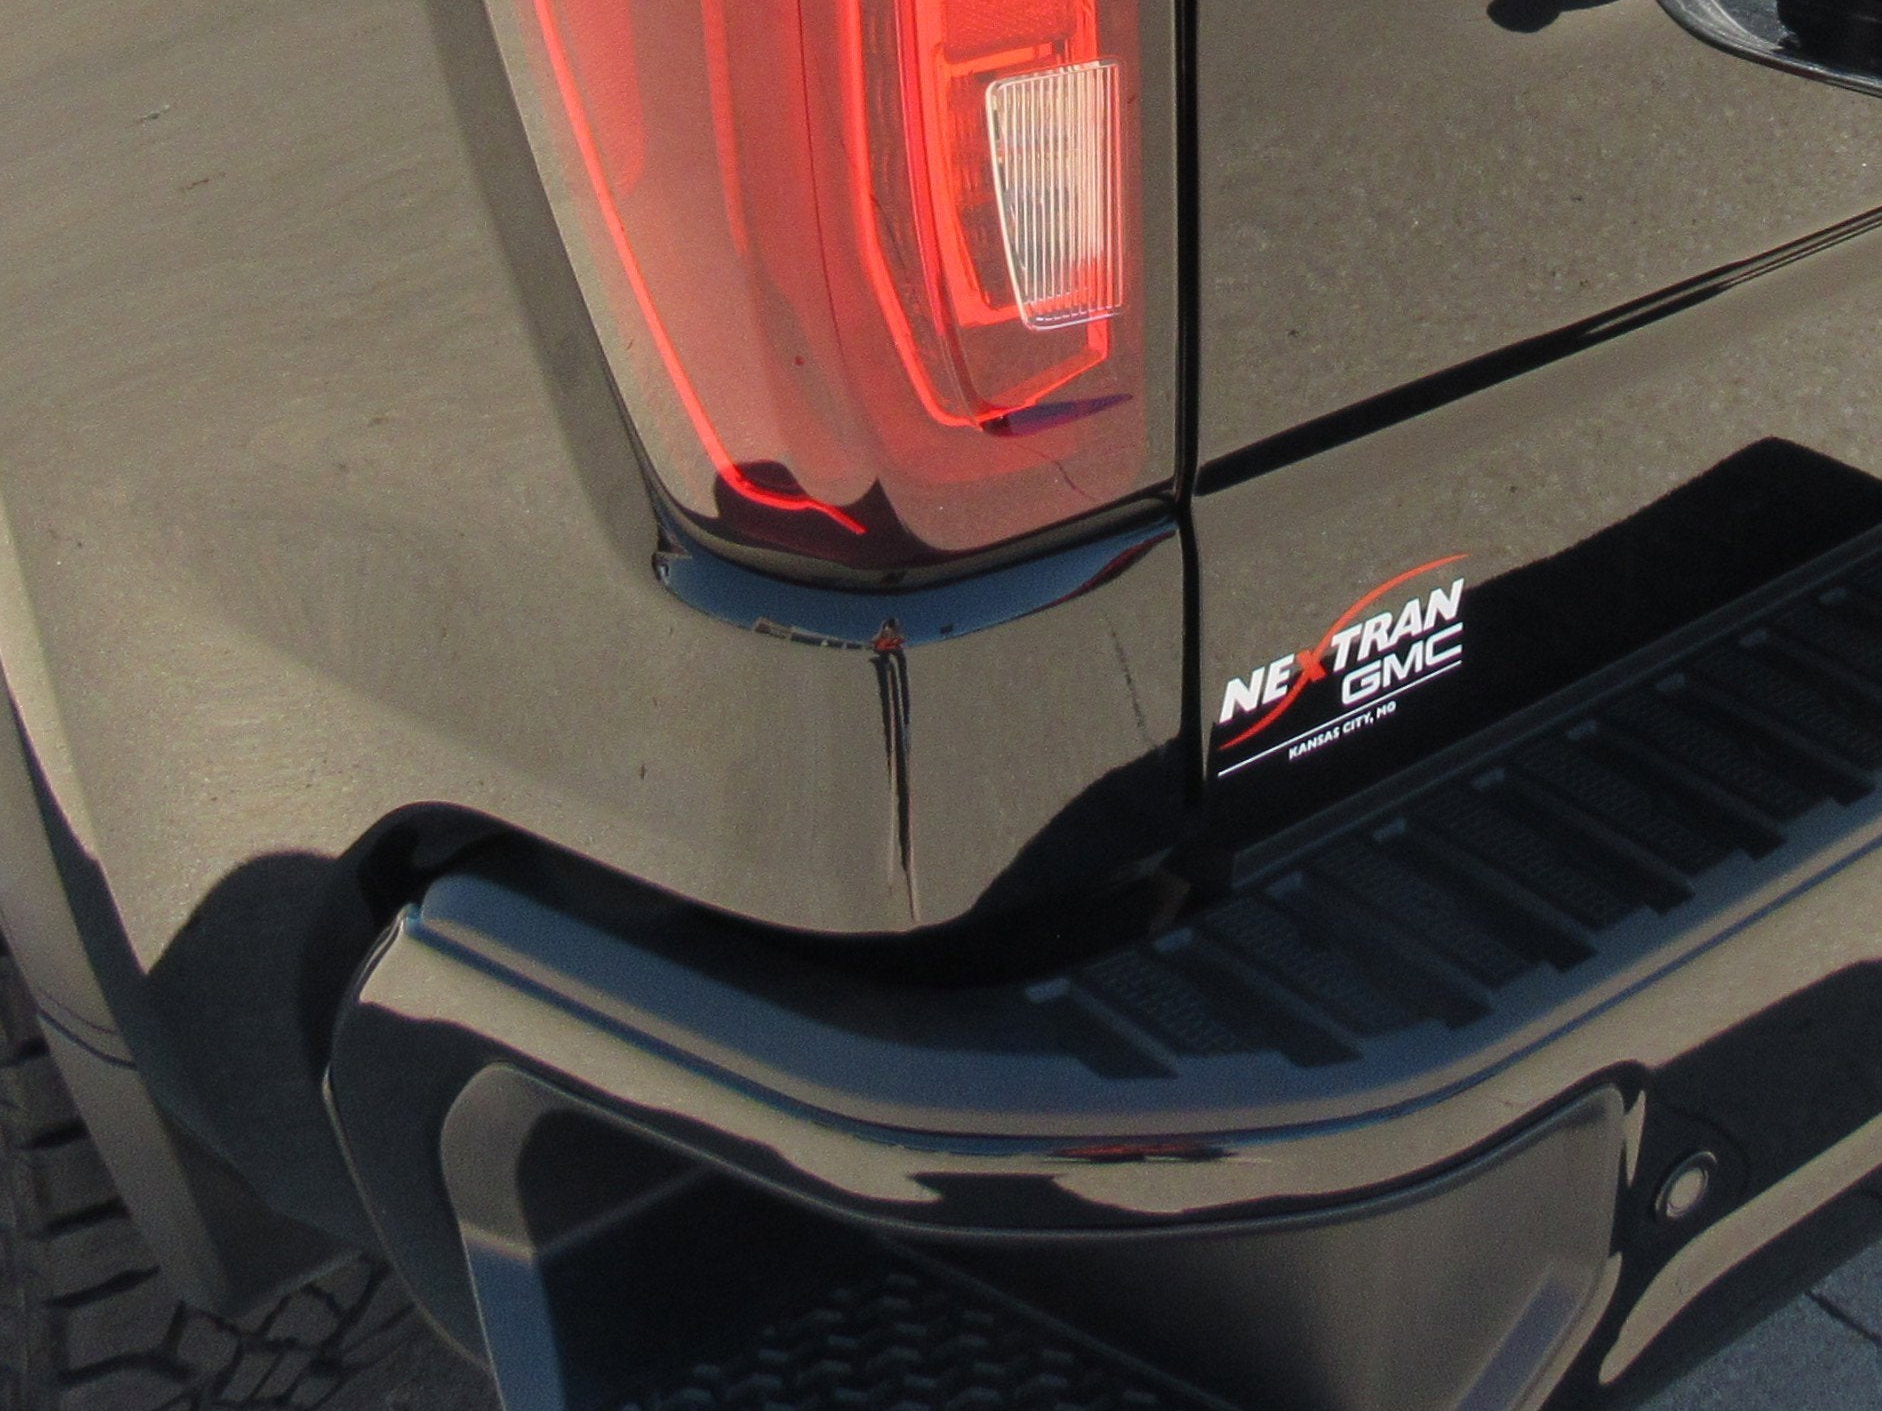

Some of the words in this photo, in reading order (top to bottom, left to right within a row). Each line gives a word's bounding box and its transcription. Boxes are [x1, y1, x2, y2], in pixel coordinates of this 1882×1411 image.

[1218, 577, 1465, 724] NEXTRAN
[1341, 622, 1464, 705] GMC
[1288, 726, 1341, 761] KANSAS
[1341, 711, 1375, 734] CITY,
[1375, 700, 1397, 720] MO
